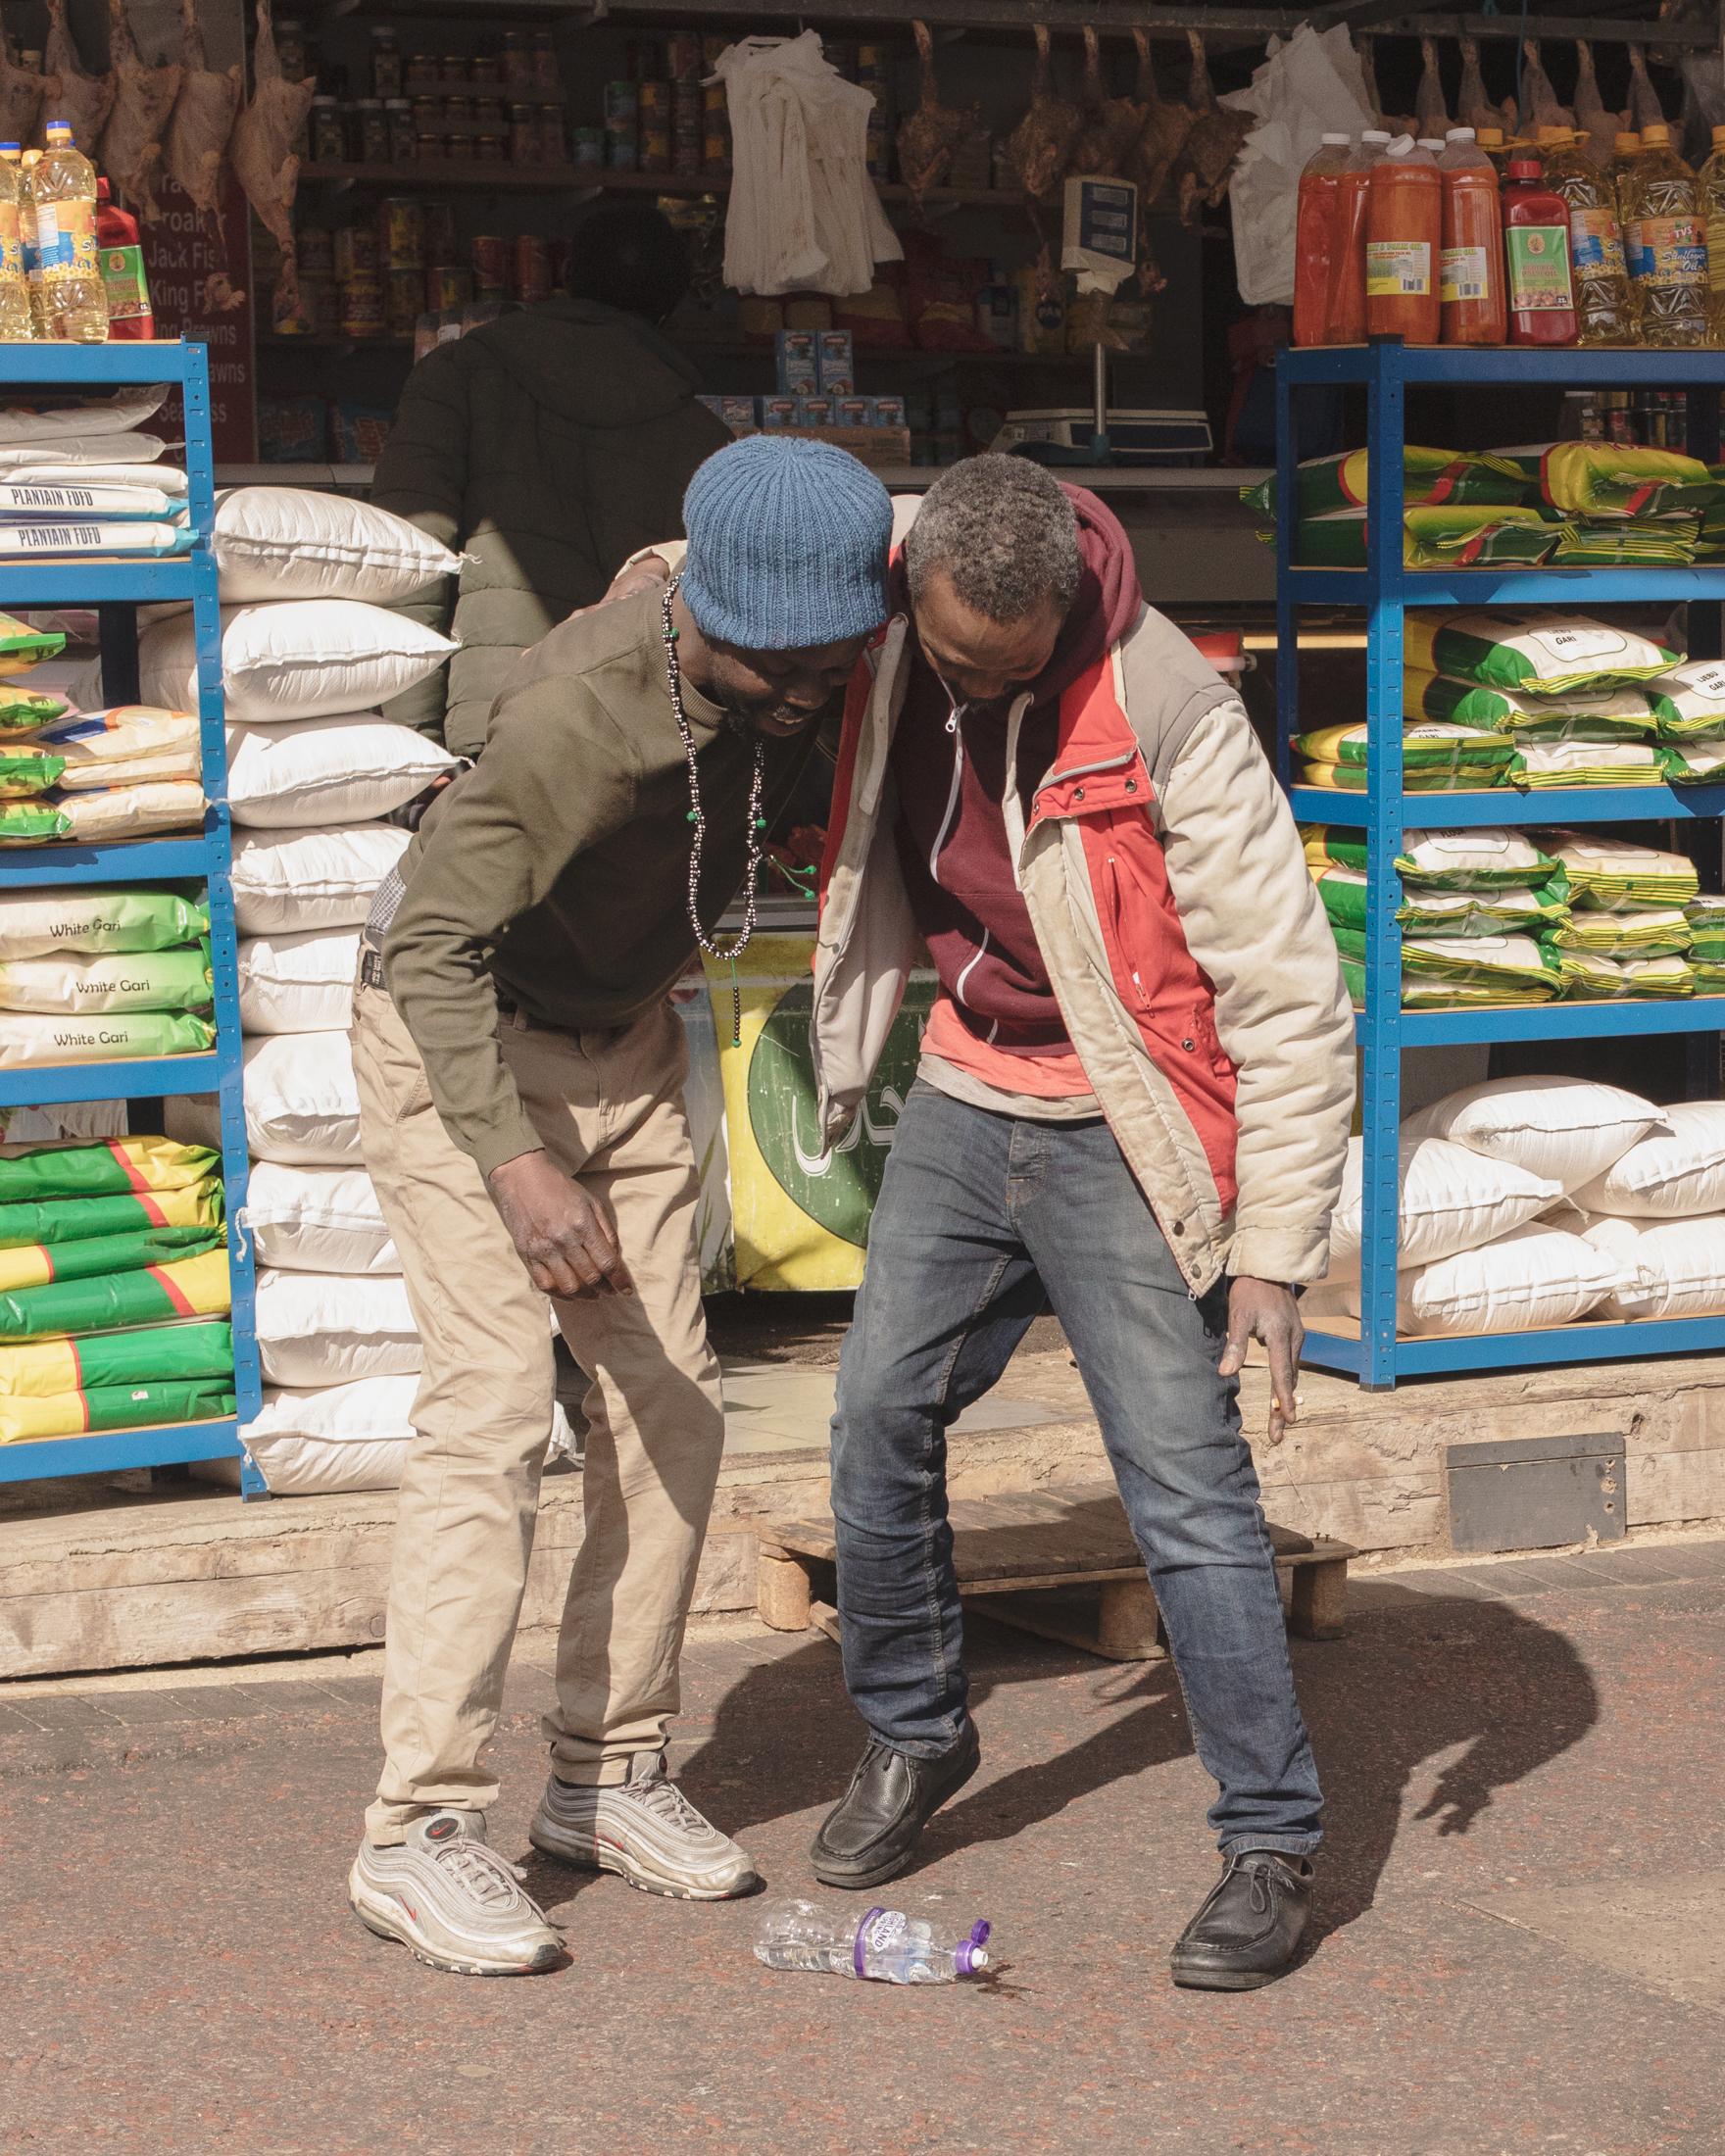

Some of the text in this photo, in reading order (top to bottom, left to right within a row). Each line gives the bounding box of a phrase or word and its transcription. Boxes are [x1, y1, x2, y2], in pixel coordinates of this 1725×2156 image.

[1674, 225, 1693, 238] TVS
[149, 241, 188, 269] Jack
[1682, 260, 1699, 271] Oil
[149, 279, 188, 314] King
[11, 488, 94, 507] PLANTAIN FUFU
[18, 526, 102, 547] PLANTAIN FUFU
[1555, 635, 1578, 645] GARI
[1696, 670, 1719, 683] IJEBU
[1440, 825, 1467, 838] FLOUR
[50, 918, 122, 938] White Gari
[75, 979, 151, 994] White Gari
[54, 1030, 128, 1047] White Gari
